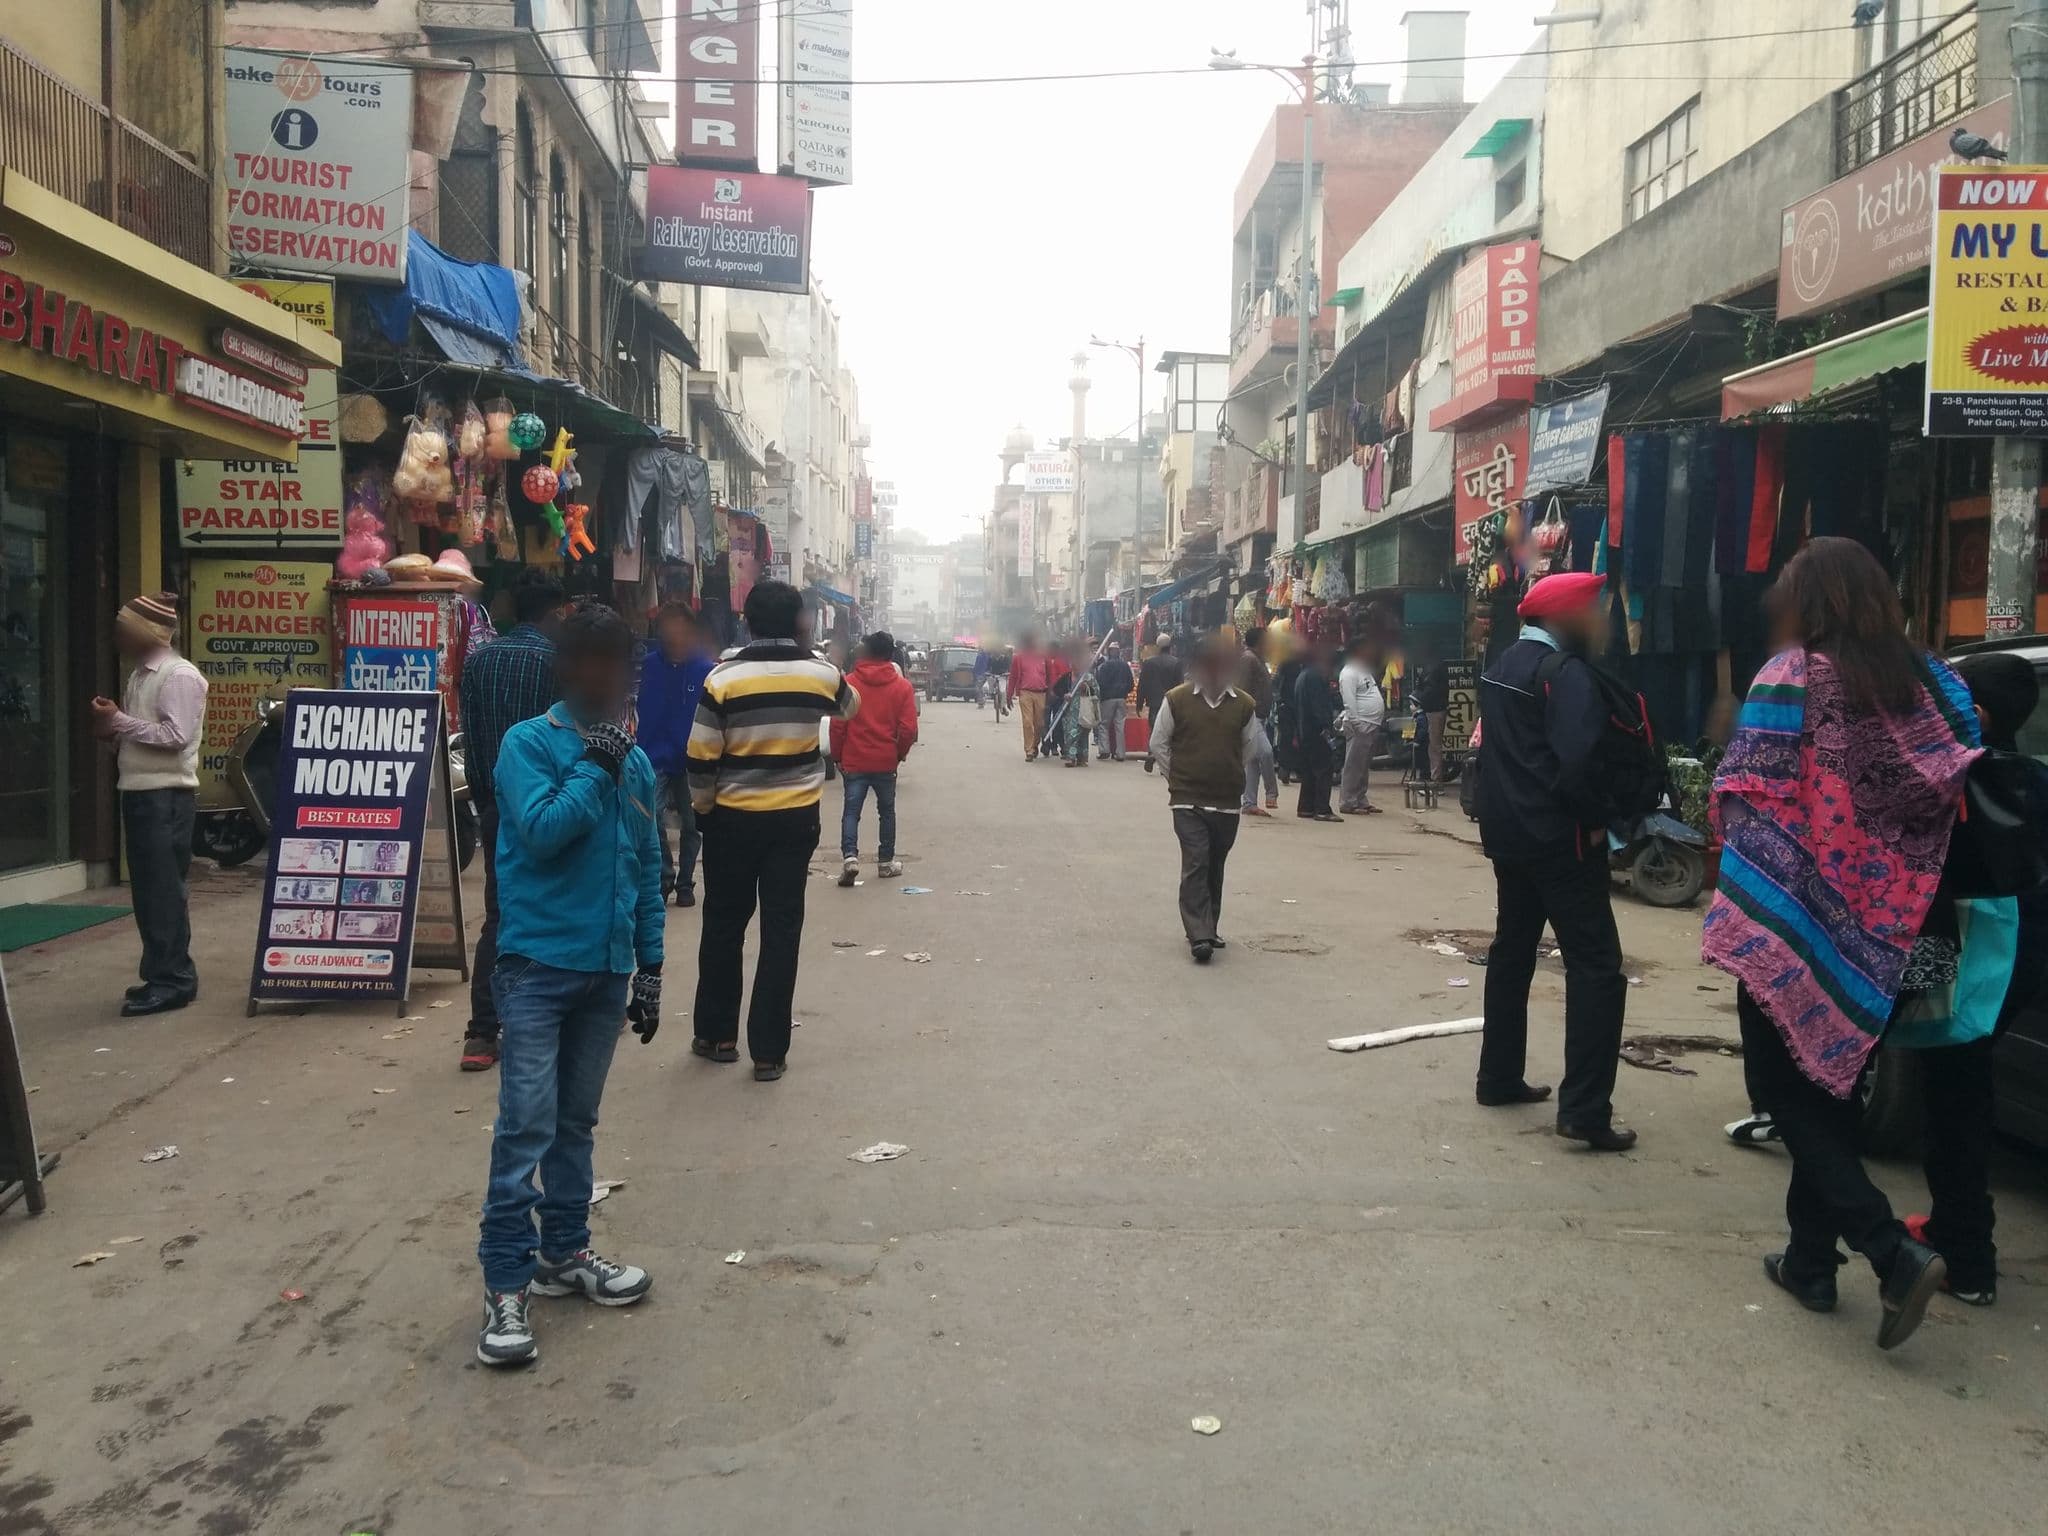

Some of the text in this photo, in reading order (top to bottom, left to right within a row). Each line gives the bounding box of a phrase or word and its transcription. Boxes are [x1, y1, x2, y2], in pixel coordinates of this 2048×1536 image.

[689, 0, 738, 147] NGER
[323, 75, 382, 96] tours
[344, 97, 381, 109] .com
[797, 118, 849, 134] AEROFLOT
[798, 140, 834, 154] QATAR
[234, 152, 353, 191] TOURIST
[819, 162, 844, 175] THAI
[1959, 180, 2037, 204] NOW
[228, 188, 385, 231] FORMATION
[700, 203, 753, 223] Instant
[653, 216, 797, 257] Railway Reservation
[1951, 223, 2016, 258] MY
[229, 224, 397, 269] ESERVATION
[685, 256, 763, 274] (Govt. Approved)
[1956, 273, 2048, 288] RESTAU
[1498, 246, 1528, 347] JADDI
[2000, 297, 2018, 313] &
[1456, 296, 1488, 350] JADDI
[0, 270, 184, 398] BHARAT
[241, 342, 274, 368] SUBHASH
[274, 356, 304, 381] CHANDER
[1492, 347, 1535, 363] DAWAKHANA
[1980, 348, 2048, 367] Live M
[1470, 367, 1488, 389] 1079
[1512, 363, 1536, 375] 1079
[186, 357, 304, 434] JEWELLERY HOUSE
[1967, 397, 2017, 406] Panchkuian
[1963, 408, 1987, 416] Metro
[2024, 408, 2045, 418] Opp.
[1968, 418, 1993, 426] Pahar
[2020, 418, 2038, 427] New
[223, 460, 298, 473] HOTEL
[220, 480, 303, 500] STAR
[182, 508, 339, 529] PARADISE
[224, 570, 253, 579] make
[277, 571, 305, 581] tours
[216, 590, 310, 610] MONEY
[199, 614, 326, 635] CHANGER
[349, 609, 435, 647] INTERNET
[213, 640, 313, 653] GOVT. APPROVED
[208, 683, 258, 694] FLIGHT
[208, 697, 251, 708] TRAIN
[208, 710, 237, 721] BUS
[208, 723, 247, 734] PACK
[292, 704, 428, 753] EXCHANGE
[293, 758, 416, 798] MONEY
[306, 811, 392, 824] BEST RATES
[275, 923, 291, 933] 100
[294, 954, 319, 966] CASH
[320, 955, 364, 968] ADVANCE
[276, 979, 309, 989] FOREX
[311, 980, 350, 990] BUREAU
[352, 981, 373, 990] PVT.
[375, 982, 395, 991] LTD.
